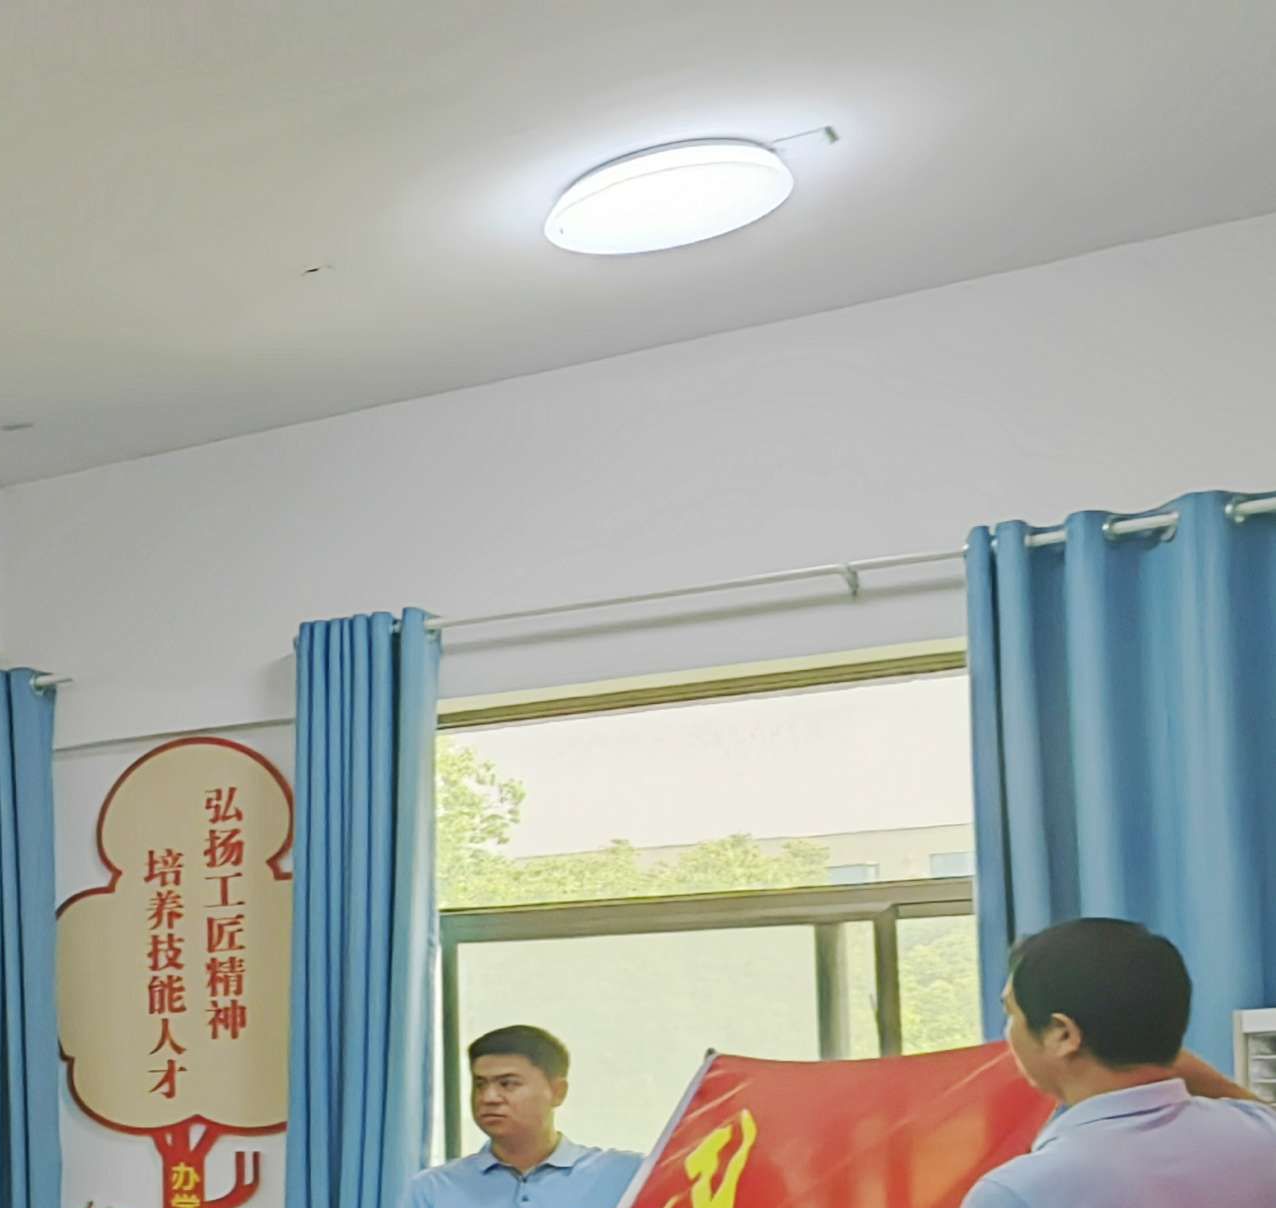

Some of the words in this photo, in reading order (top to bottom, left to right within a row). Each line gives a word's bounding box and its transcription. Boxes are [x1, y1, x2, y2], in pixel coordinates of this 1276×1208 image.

[143, 848, 188, 1099] 培养技能人才
[203, 786, 247, 1040] 弘扬工匠精神
